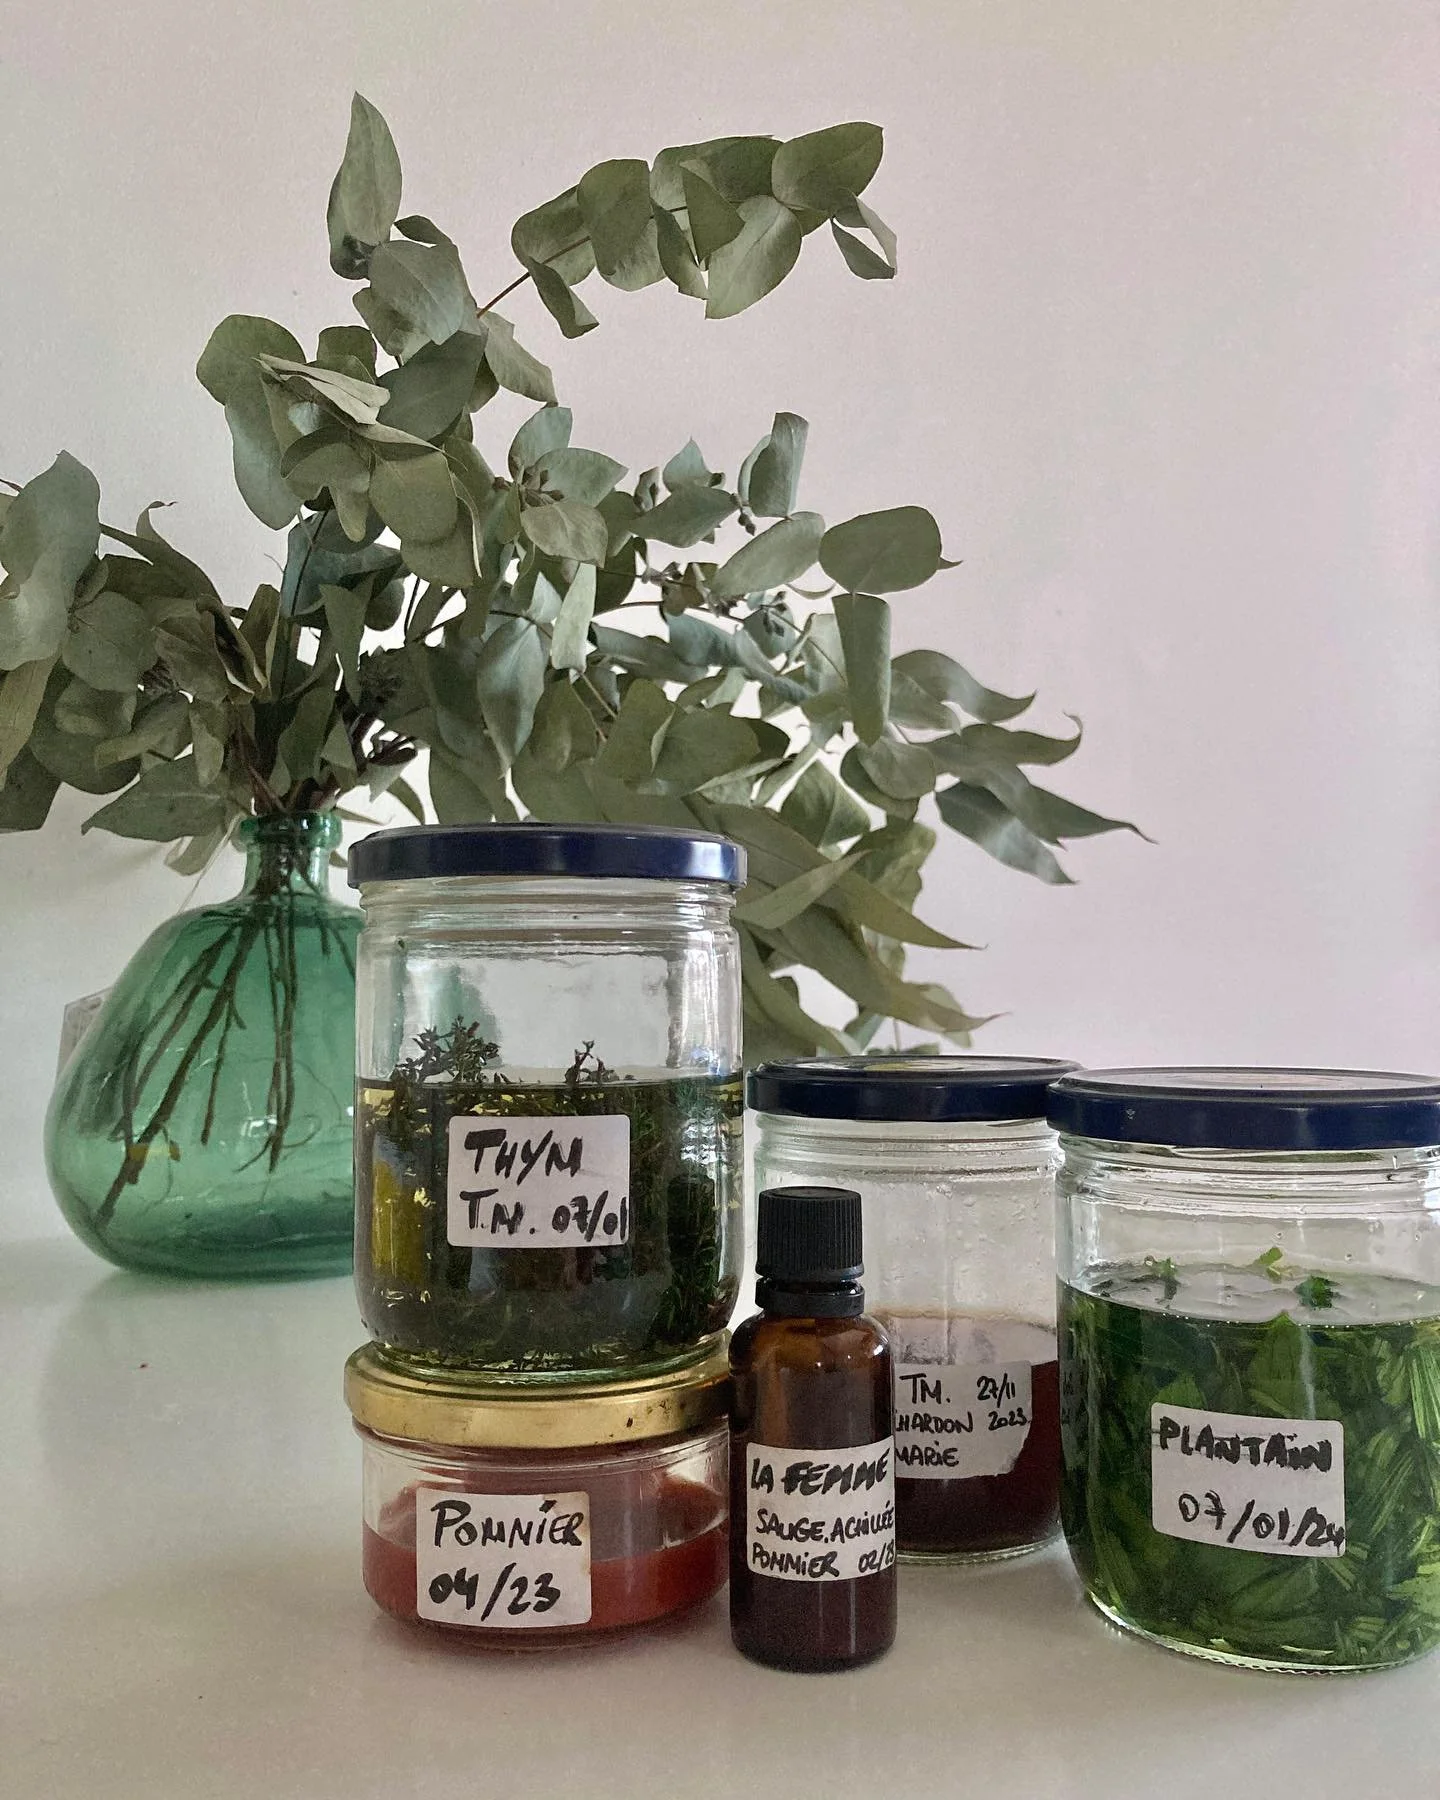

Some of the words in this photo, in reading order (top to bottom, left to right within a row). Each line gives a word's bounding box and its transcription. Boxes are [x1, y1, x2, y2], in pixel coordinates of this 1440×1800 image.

[899, 1373, 951, 1405] TM.
[976, 1373, 1016, 1409] 27/11
[894, 1408, 974, 1434] HARDON
[988, 1407, 1029, 1431] 2023
[751, 1457, 775, 1494] LA
[781, 1447, 891, 1496] FEMME
[428, 1562, 561, 1622] 04/23
